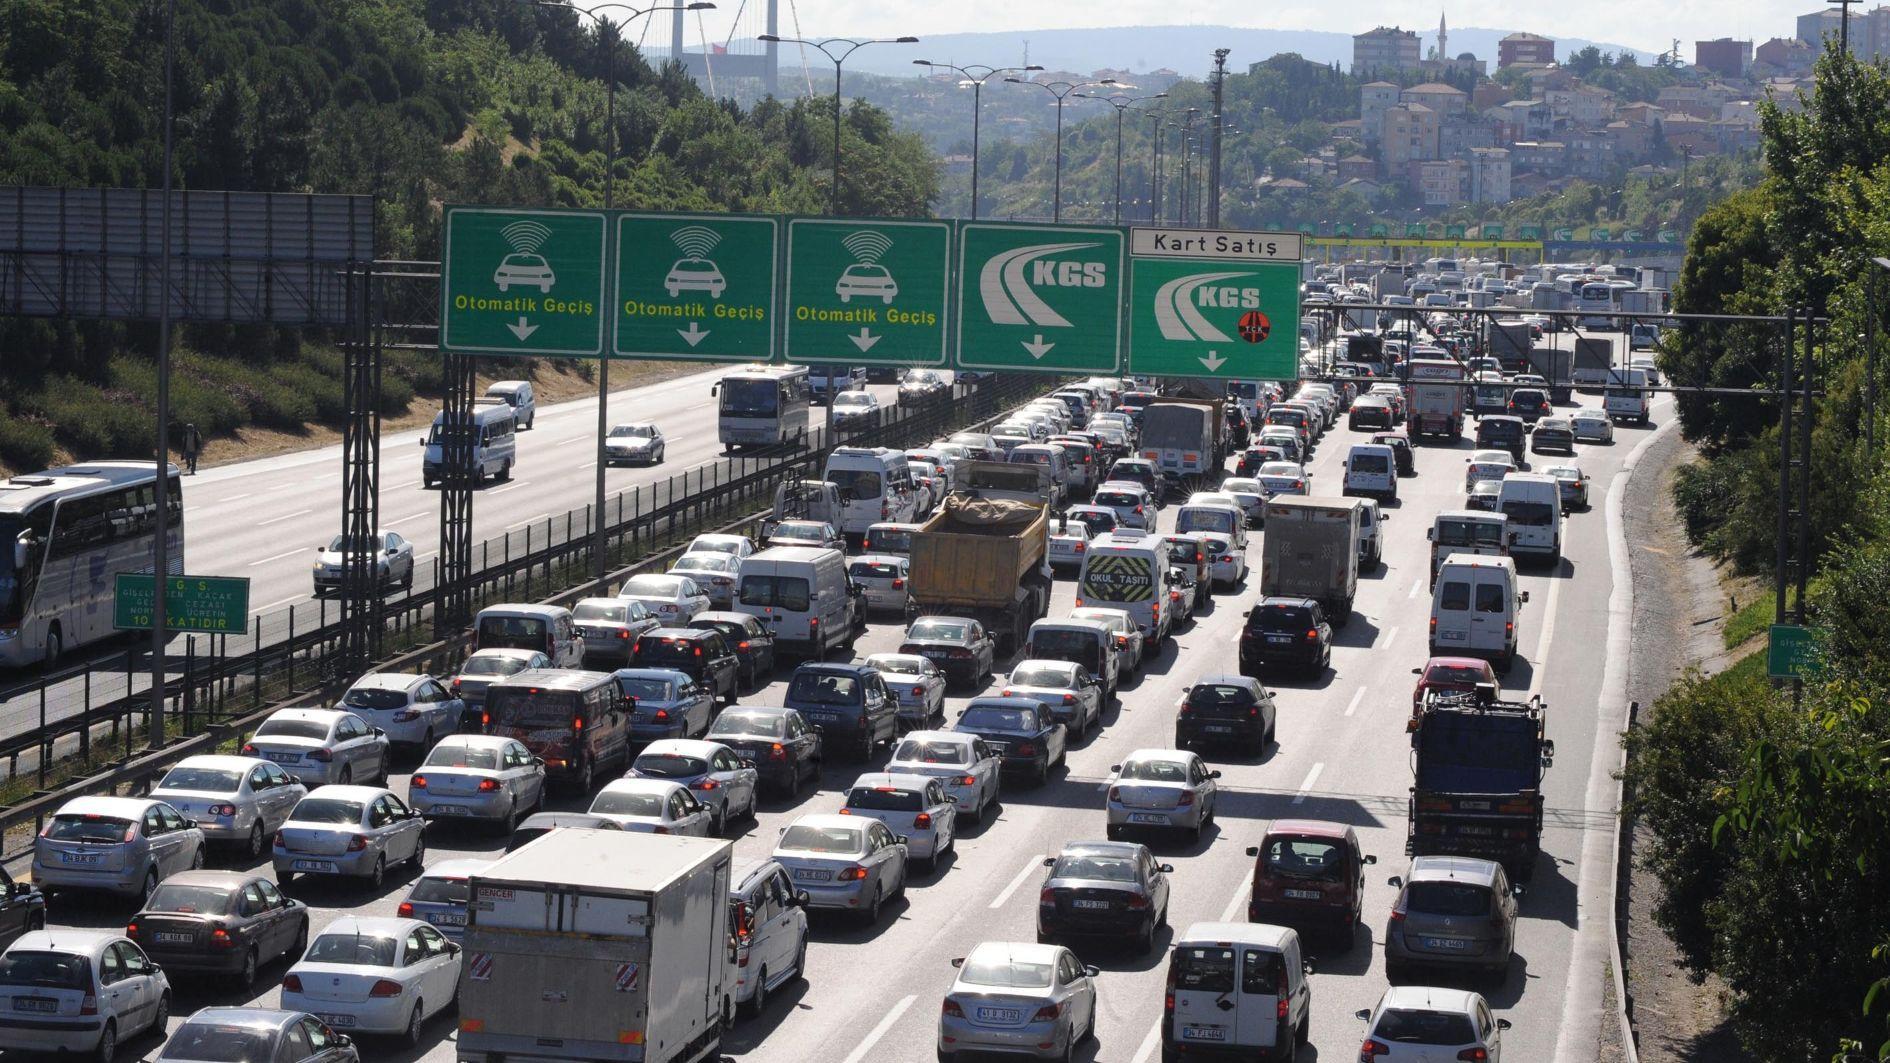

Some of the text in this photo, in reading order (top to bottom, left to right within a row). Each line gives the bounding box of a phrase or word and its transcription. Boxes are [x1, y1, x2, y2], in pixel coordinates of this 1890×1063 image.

[1154, 234, 1277, 256] Kart Satış
[1033, 260, 1106, 288] KGS
[455, 295, 593, 316] Otomatik Geçiş
[1198, 286, 1260, 309] KGS
[624, 300, 765, 321] Otomatik Geçiş
[796, 306, 936, 326] Otomatik Geçiş
[1090, 573, 1114, 583] OKUL
[134, 616, 226, 629] 10 KATIDIR
